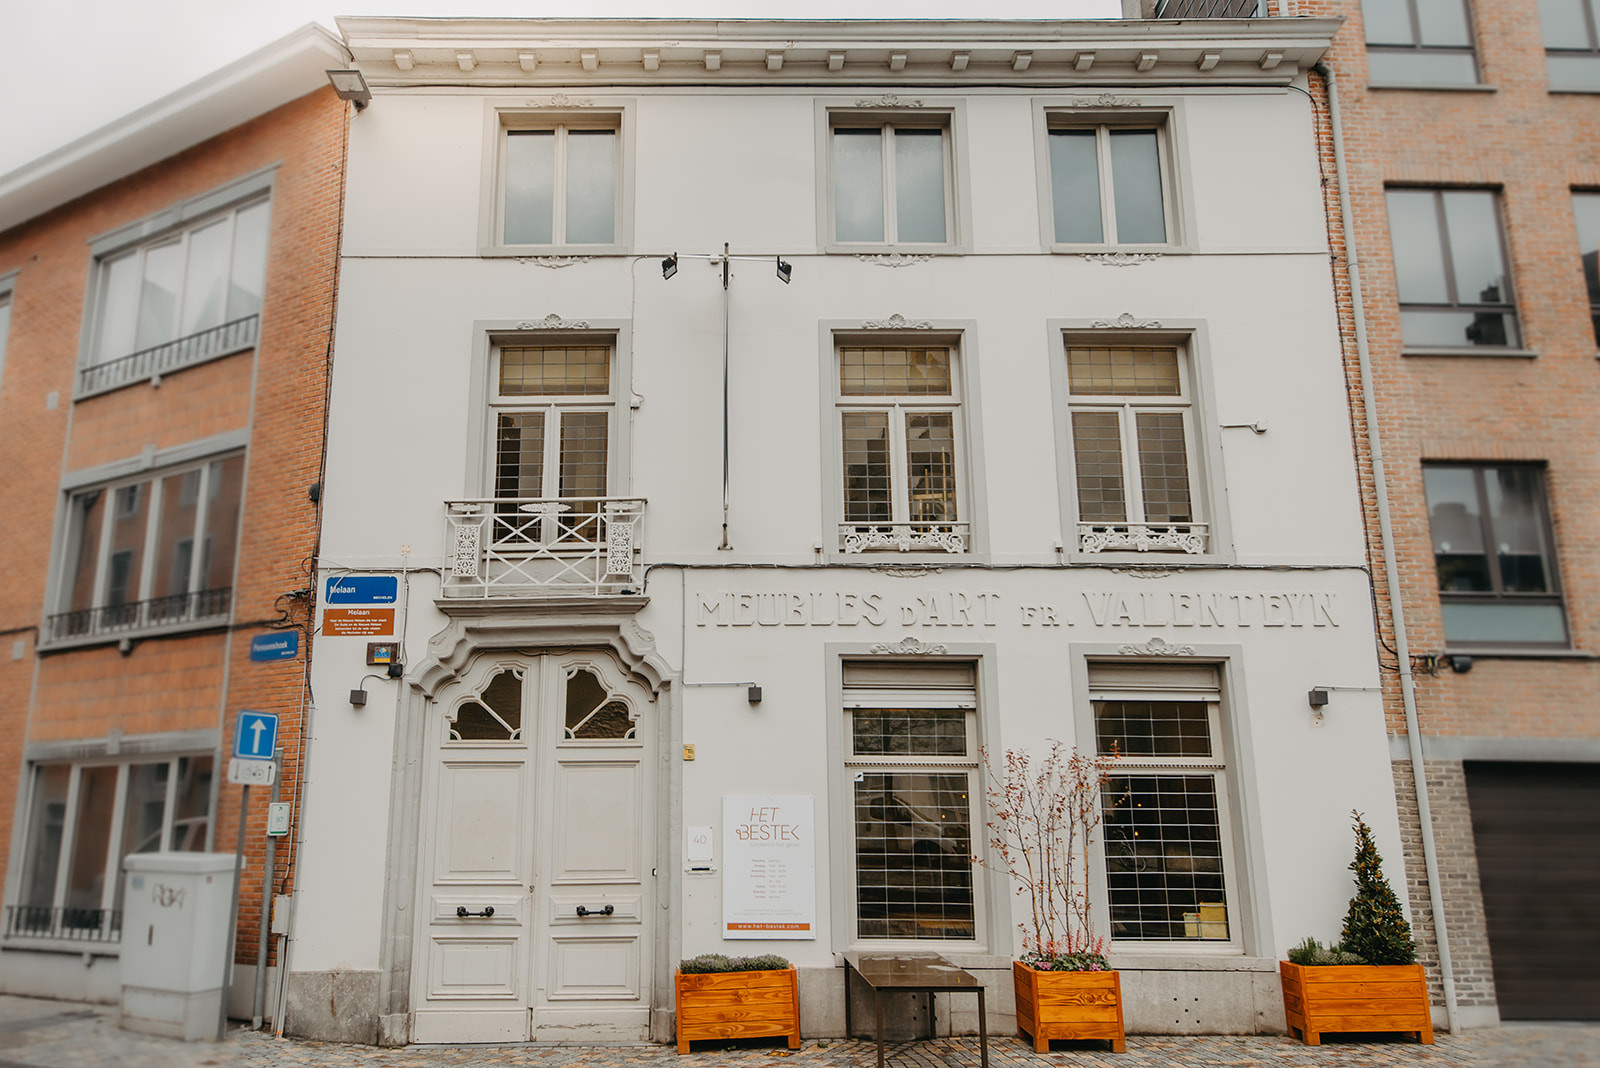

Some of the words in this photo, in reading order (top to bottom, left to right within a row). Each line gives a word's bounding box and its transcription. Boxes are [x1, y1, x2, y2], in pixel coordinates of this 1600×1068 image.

[330, 586, 356, 594] Melaan
[696, 592, 887, 627] MEUBLES
[1020, 604, 1075, 627] FR.
[1081, 592, 1340, 628] VALENTEYN
[750, 807, 780, 822] HET
[693, 835, 707, 844] 40
[736, 824, 800, 840] BESTEK
